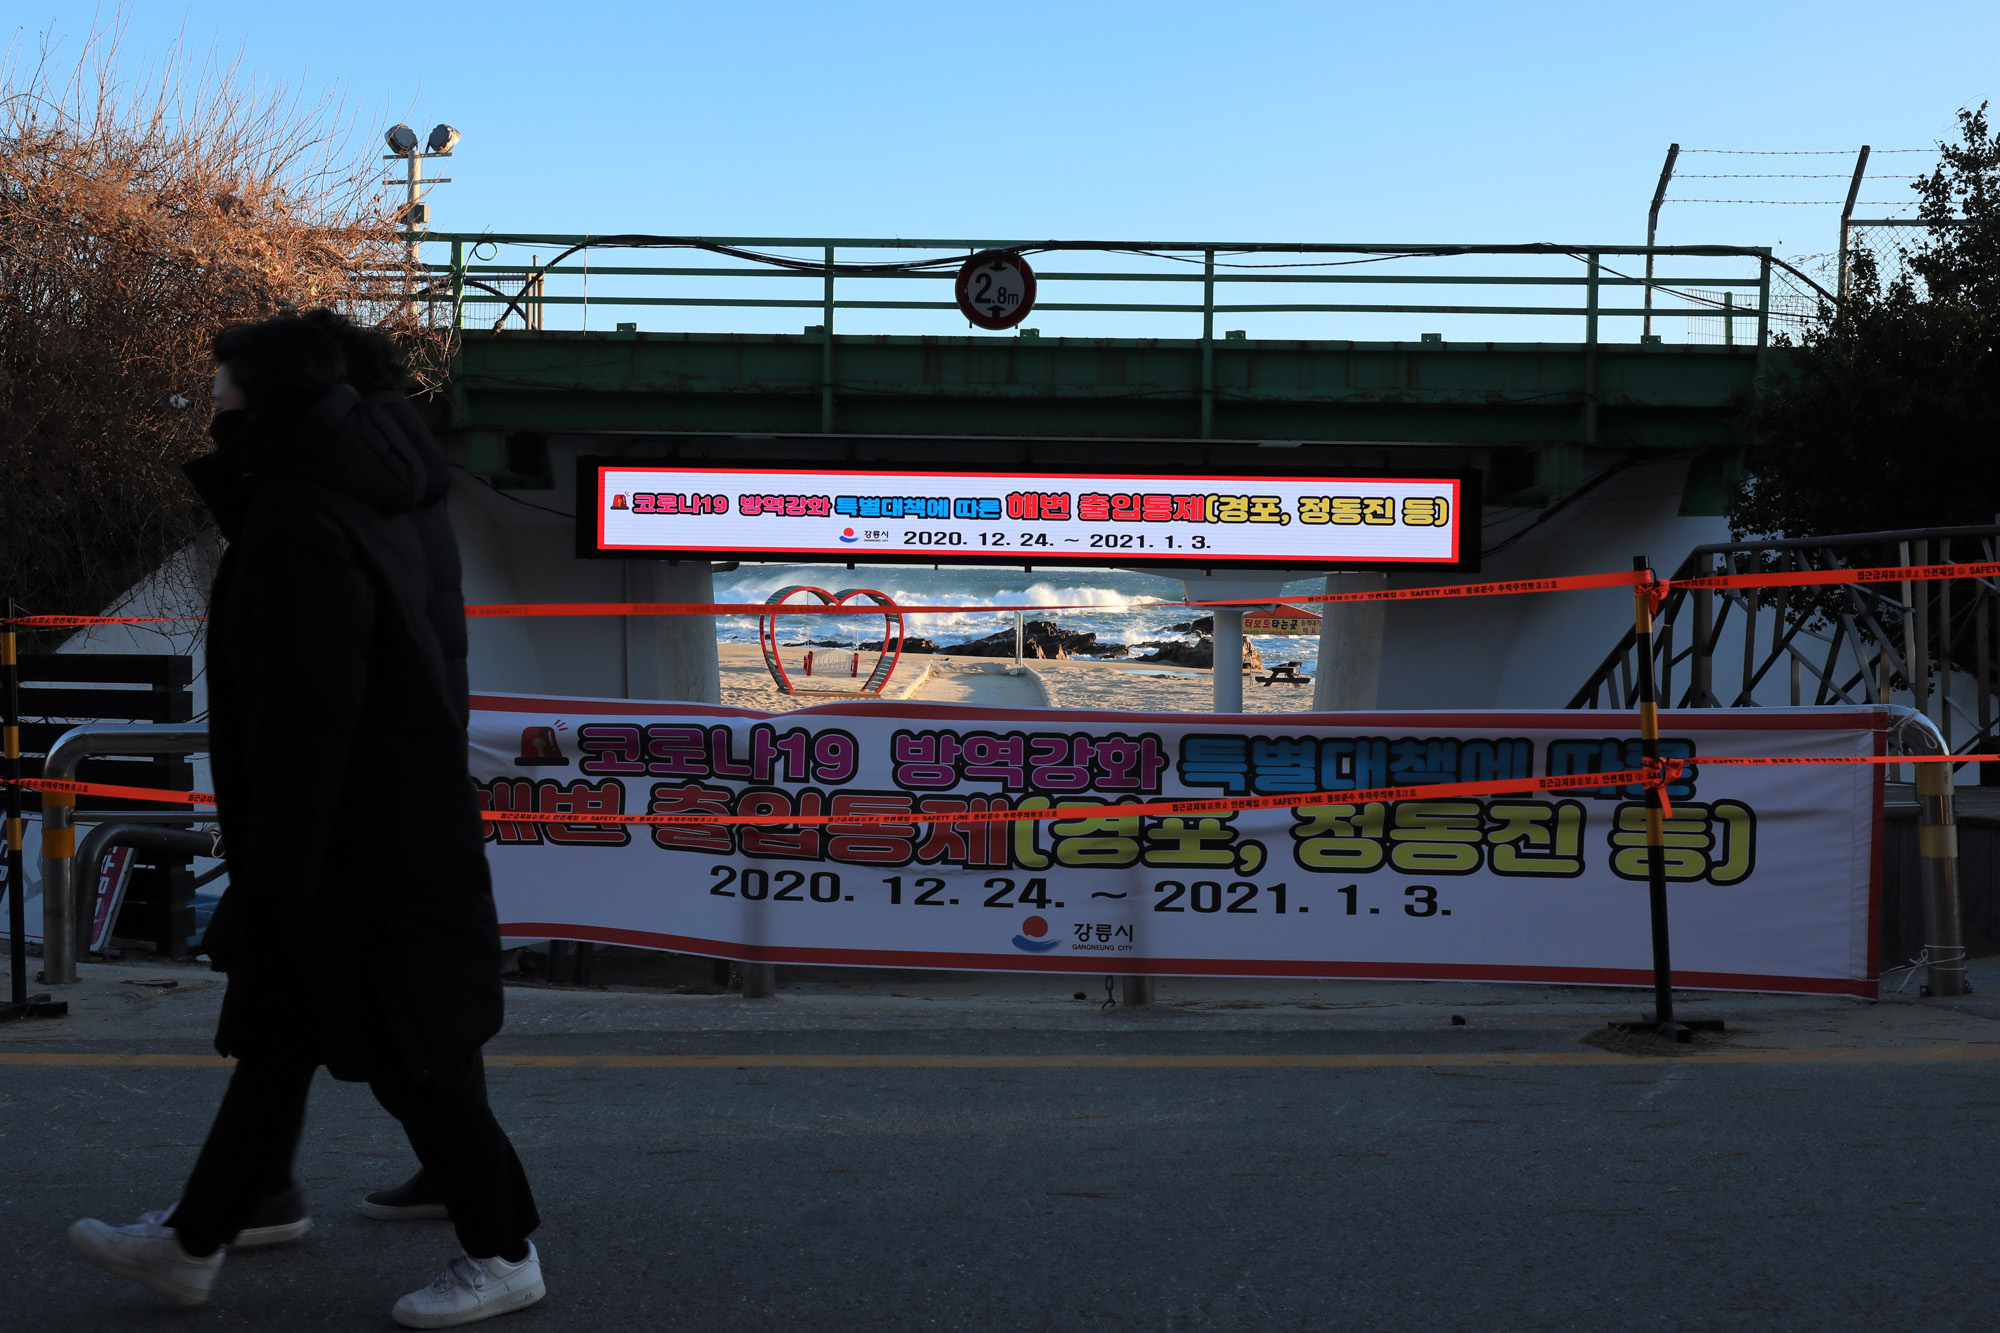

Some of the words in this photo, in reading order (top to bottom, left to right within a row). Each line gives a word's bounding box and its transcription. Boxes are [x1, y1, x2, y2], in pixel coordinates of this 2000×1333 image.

[974, 272, 1019, 305] 2.8m
[631, 492, 729, 515] 코로나19
[738, 494, 832, 517] 방역강화
[834, 495, 951, 519] 특별대책에
[954, 497, 1002, 519] 따른
[1006, 491, 1071, 521] 해변
[1298, 495, 1396, 526] 정동진
[1401, 497, 1449, 527] 등)
[864, 530, 889, 539] 강릉시
[903, 531, 968, 546] 2020.
[978, 532, 1011, 546] 12.
[1020, 533, 1054, 547] 24.
[1089, 534, 1154, 549] 2021.
[1165, 536, 1182, 549] 1.
[1191, 536, 1212, 549] 3.
[1410, 589, 1440, 597] SAFETY
[1444, 587, 1462, 596] LINE
[577, 722, 859, 785] 코로나19
[890, 728, 1170, 795] 방역강화
[1176, 733, 1534, 799] 특별대책에
[1273, 795, 1302, 806] SAFETY
[1305, 795, 1324, 804] LINE
[922, 814, 950, 822] SAFETY
[1289, 797, 1586, 878] 정동진
[1608, 799, 1757, 887] 등)
[709, 865, 855, 903] 2020.
[882, 875, 960, 907] 12.
[983, 877, 1065, 909] 24.
[1154, 880, 1309, 914] 2021.
[1337, 884, 1380, 916] 1.
[1404, 885, 1452, 917] 3.
[1073, 923, 1133, 943] 강릉시
